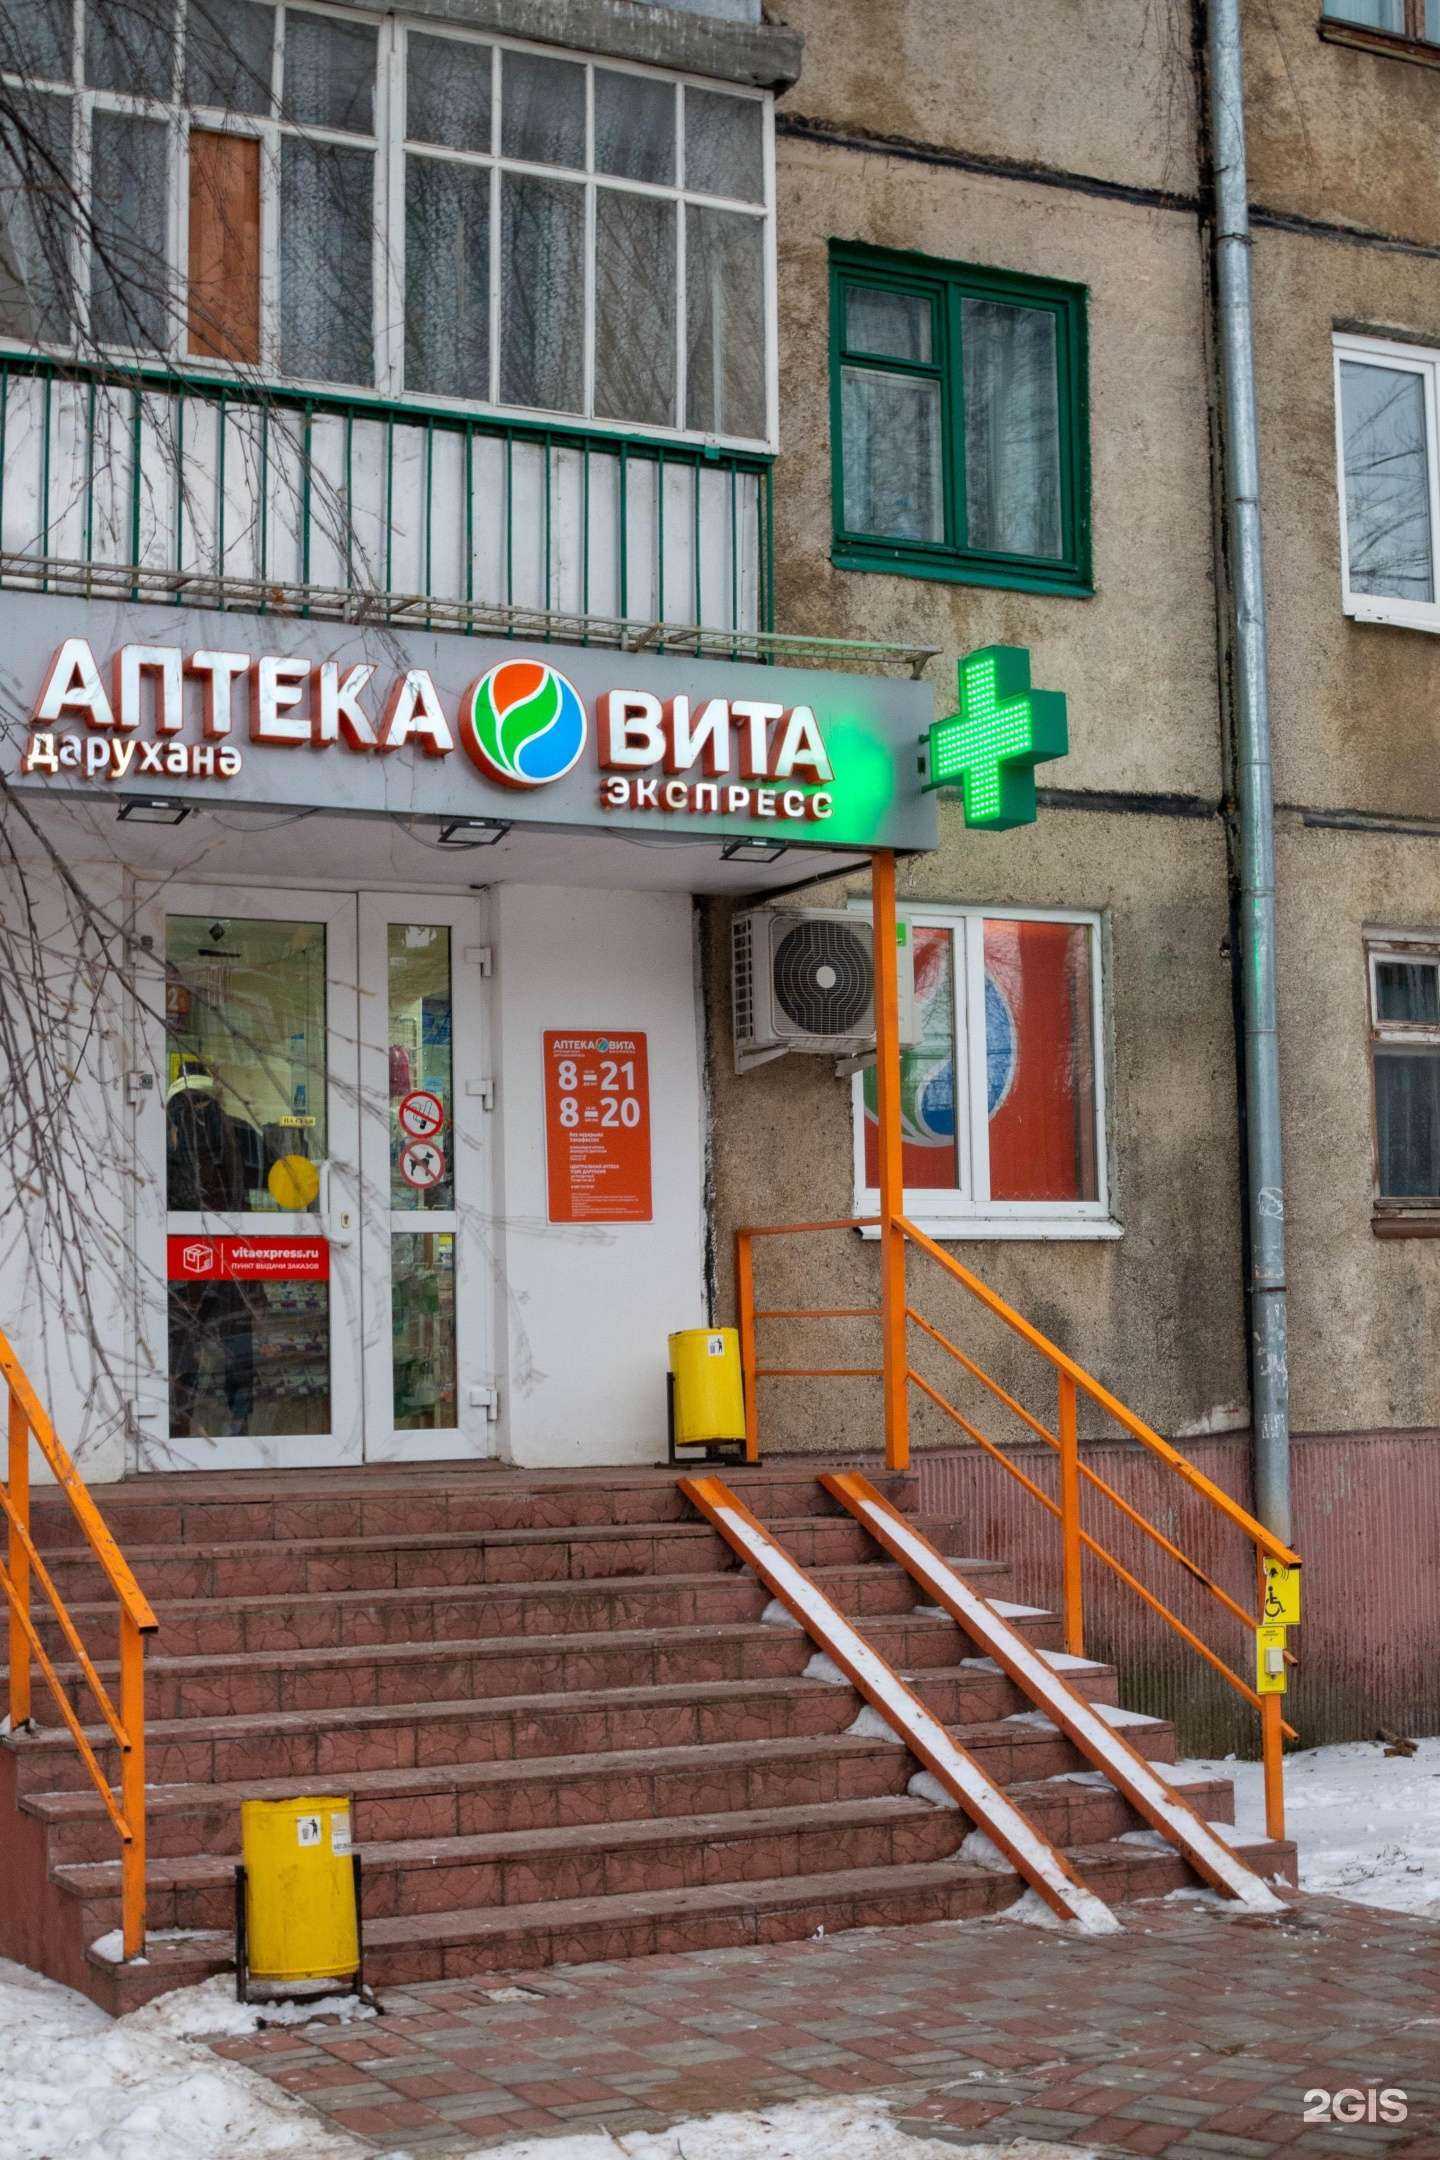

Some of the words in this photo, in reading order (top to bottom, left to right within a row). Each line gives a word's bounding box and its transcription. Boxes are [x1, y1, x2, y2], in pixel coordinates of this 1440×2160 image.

[34, 638, 455, 752] АПТЕКА
[601, 689, 835, 782] ВИТА
[24, 733, 243, 779] даруханә
[604, 776, 833, 819] ЭКСПРЕСС
[553, 1040, 596, 1050] АПТЕКА
[608, 1041, 636, 1050] ВИТА
[232, 1247, 319, 1260] vitaexpress.ru
